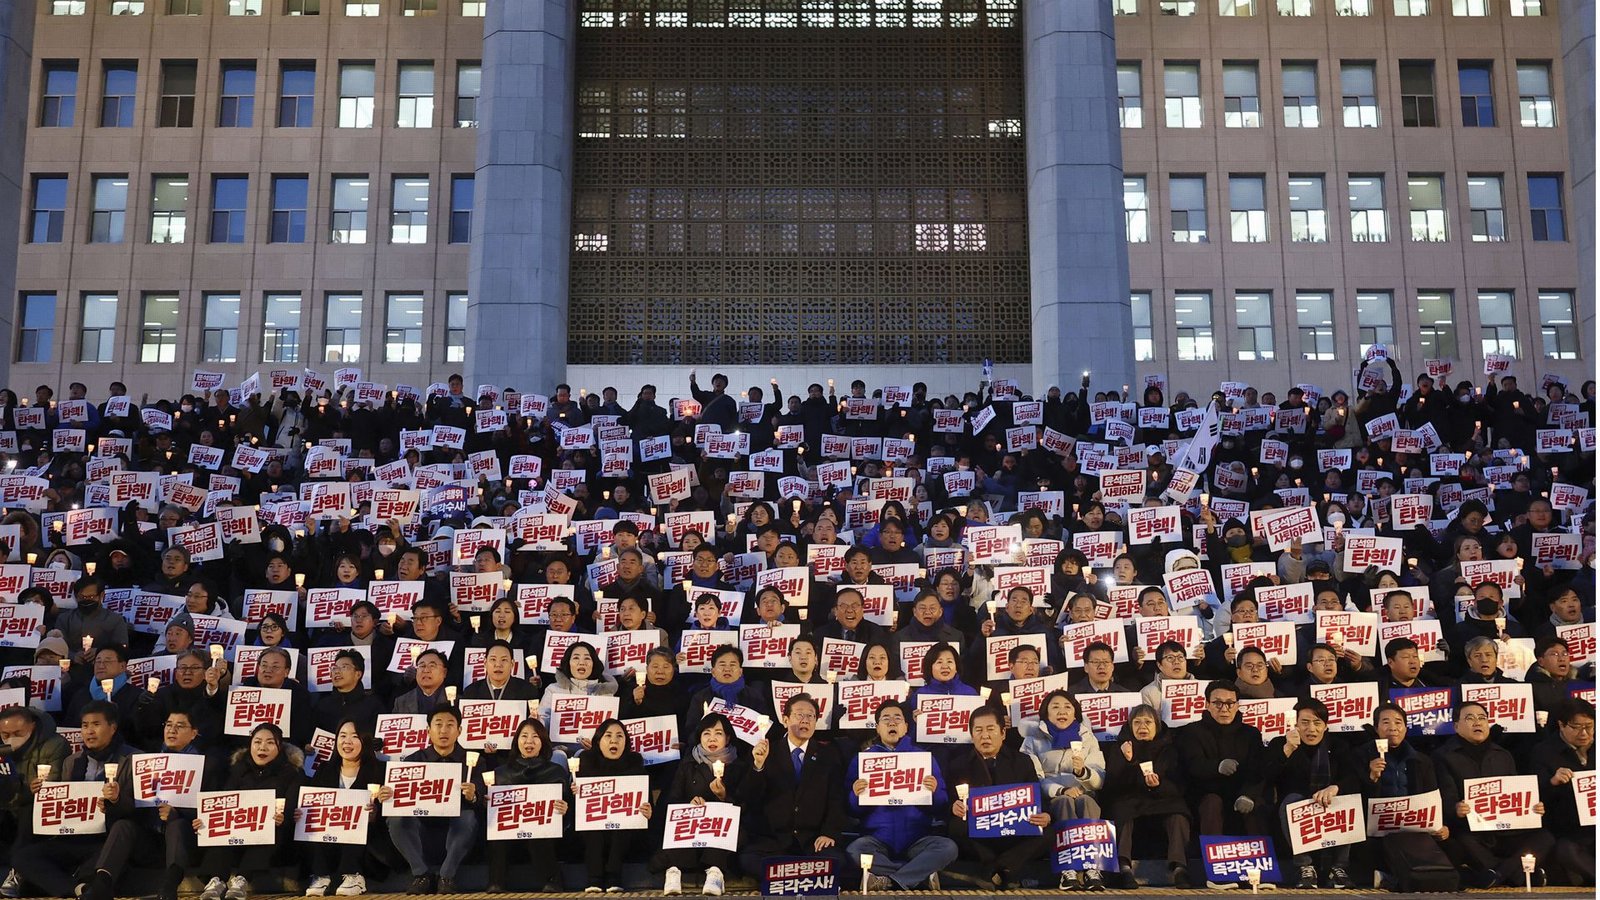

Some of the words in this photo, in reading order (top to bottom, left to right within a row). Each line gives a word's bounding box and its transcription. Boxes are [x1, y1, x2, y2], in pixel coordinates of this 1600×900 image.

[273, 376, 297, 387] 탄핵!
[358, 389, 383, 399] 탄핵!
[887, 393, 909, 403] 탄핵!
[63, 407, 83, 417] 탄핵!
[481, 416, 504, 427] 탄핵!
[57, 436, 81, 446] 탄핵!
[436, 432, 461, 442] 탄핵!
[1012, 434, 1034, 447] 탄핵!
[1396, 437, 1422, 449] 탄핵!
[1542, 438, 1568, 448] 탄핵!
[709, 442, 735, 452] 탄핵!
[824, 443, 847, 453] 탄핵!
[1045, 437, 1071, 451] 탄핵!
[193, 454, 218, 464] 탄핵!
[237, 455, 263, 466] 탄핵!
[1323, 457, 1346, 467] 탄핵!
[513, 463, 537, 473] 탄핵!
[2, 479, 24, 487] 윤석열
[113, 475, 136, 484] 윤석열
[652, 474, 672, 485] 윤석열
[1103, 472, 1141, 485] 윤석열은
[3, 484, 42, 500] 탄핵!
[117, 484, 151, 500] 탄핵!
[657, 479, 686, 499] 탄핵!
[733, 480, 760, 492] 탄핵!
[1104, 486, 1143, 497] 사퇴하라!
[172, 493, 201, 506] 탄핵!
[376, 492, 398, 500] 윤석열
[876, 488, 908, 500] 탄핵!
[1555, 493, 1582, 506] 탄핵!
[311, 493, 345, 513] 탄핵!
[1394, 497, 1419, 508] 윤석열
[377, 502, 413, 518] 탄핵!
[1399, 507, 1431, 522] 탄핵!
[70, 512, 91, 522] 윤석열
[520, 518, 542, 527] 윤석열
[668, 515, 689, 525] 윤석열
[1131, 512, 1155, 522] 윤석열
[1267, 511, 1311, 534] 윤석열은
[73, 519, 113, 539] 탄핵!
[223, 518, 252, 534] 탄핵!
[579, 523, 602, 533] 윤석열
[672, 522, 709, 542] 탄핵!
[1137, 517, 1175, 539] 탄핵!
[175, 526, 215, 541] 윤석열은
[457, 532, 480, 541] 윤석열
[523, 525, 562, 543] 탄핵!
[972, 530, 996, 540] 윤석열
[1274, 523, 1315, 546] 사퇴하라!
[1076, 536, 1098, 545] 윤석열
[1349, 539, 1375, 548] 윤석열
[1535, 536, 1559, 546] 윤석열
[976, 537, 1017, 558] 탄핵!
[1081, 544, 1117, 561] 탄핵!
[1538, 546, 1577, 562] 탄핵!
[1352, 550, 1396, 566] 탄핵!
[1465, 564, 1491, 575] 윤석열
[453, 576, 475, 586] 윤석열
[760, 571, 783, 584] 윤석열
[1001, 571, 1044, 585] 윤석열은
[1170, 573, 1209, 590] 윤석열은
[311, 592, 338, 601] 윤석열
[373, 585, 398, 595] 윤석열
[458, 585, 497, 604] 탄핵!
[521, 589, 547, 598] 윤석열
[1177, 587, 1212, 602] 사퇴하라!
[1259, 589, 1286, 600] 윤석열
[134, 595, 160, 605] 윤석열
[375, 593, 418, 612] 탄핵!
[1266, 595, 1308, 619] 탄핵!
[1141, 622, 1168, 632] 윤석열
[1321, 616, 1349, 625] 윤석열
[744, 628, 770, 639] 윤석열
[1067, 625, 1094, 636] 윤석열
[1237, 627, 1265, 639] 윤석열
[1382, 625, 1411, 638] 윤석열
[194, 629, 237, 650] 탄핵!
[549, 636, 578, 646] 윤석열
[683, 633, 709, 645] 윤석열
[1147, 629, 1191, 653] 탄핵!
[608, 643, 653, 663] 탄핵!
[748, 638, 790, 659] 탄핵!
[826, 643, 855, 654] 윤석열
[843, 684, 873, 696] 윤석열
[1014, 682, 1043, 696] 윤석열
[1167, 683, 1197, 696] 윤석열
[1316, 689, 1345, 700] 윤석열
[1467, 689, 1499, 701] 윤석열
[231, 691, 261, 704] 윤석열
[1399, 692, 1448, 711] 내란행위
[463, 704, 493, 716] 윤석열
[556, 700, 586, 711] 윤석열
[922, 698, 952, 711] 윤석열
[1081, 698, 1110, 711] 윤석열
[234, 704, 283, 727] 탄핵!
[380, 718, 411, 730] 윤석열
[467, 716, 519, 740] 탄핵!
[559, 711, 611, 734] 탄핵!
[137, 758, 168, 773] 윤석열
[864, 756, 896, 772] 윤석열
[390, 767, 423, 780] 윤석열
[140, 770, 195, 798] 탄핵!
[580, 781, 613, 794] 윤석열
[869, 768, 923, 796] 탄핵!
[38, 787, 67, 801] 윤석열
[394, 779, 453, 807] 탄핵!
[1469, 782, 1501, 797] 윤석열
[202, 795, 239, 811] 윤석열
[302, 792, 334, 806] 윤석열
[492, 790, 526, 804] 윤석열
[975, 788, 1031, 812] 내란행위
[42, 797, 98, 824] 탄핵!
[586, 792, 642, 822] 탄핵!
[1373, 800, 1409, 814] 윤석열
[1476, 792, 1531, 819] 탄핵!
[498, 800, 554, 830] 탄핵!
[671, 808, 704, 820] 윤석열
[976, 806, 1037, 831] 즉각수사!
[1378, 806, 1435, 830] 탄핵!
[208, 813, 266, 838] 탄핵!
[305, 812, 358, 832] 탄핵!
[1301, 810, 1354, 844] 탄핵!
[674, 818, 732, 841] 탄핵!
[1056, 825, 1108, 848] 내란행위
[1058, 844, 1113, 864] 즉각수사!
[1209, 841, 1265, 860] 내란행위
[770, 862, 828, 878] 내란행위
[1213, 857, 1273, 875] 즉각수사!
[770, 876, 834, 894] 즉각수사!
